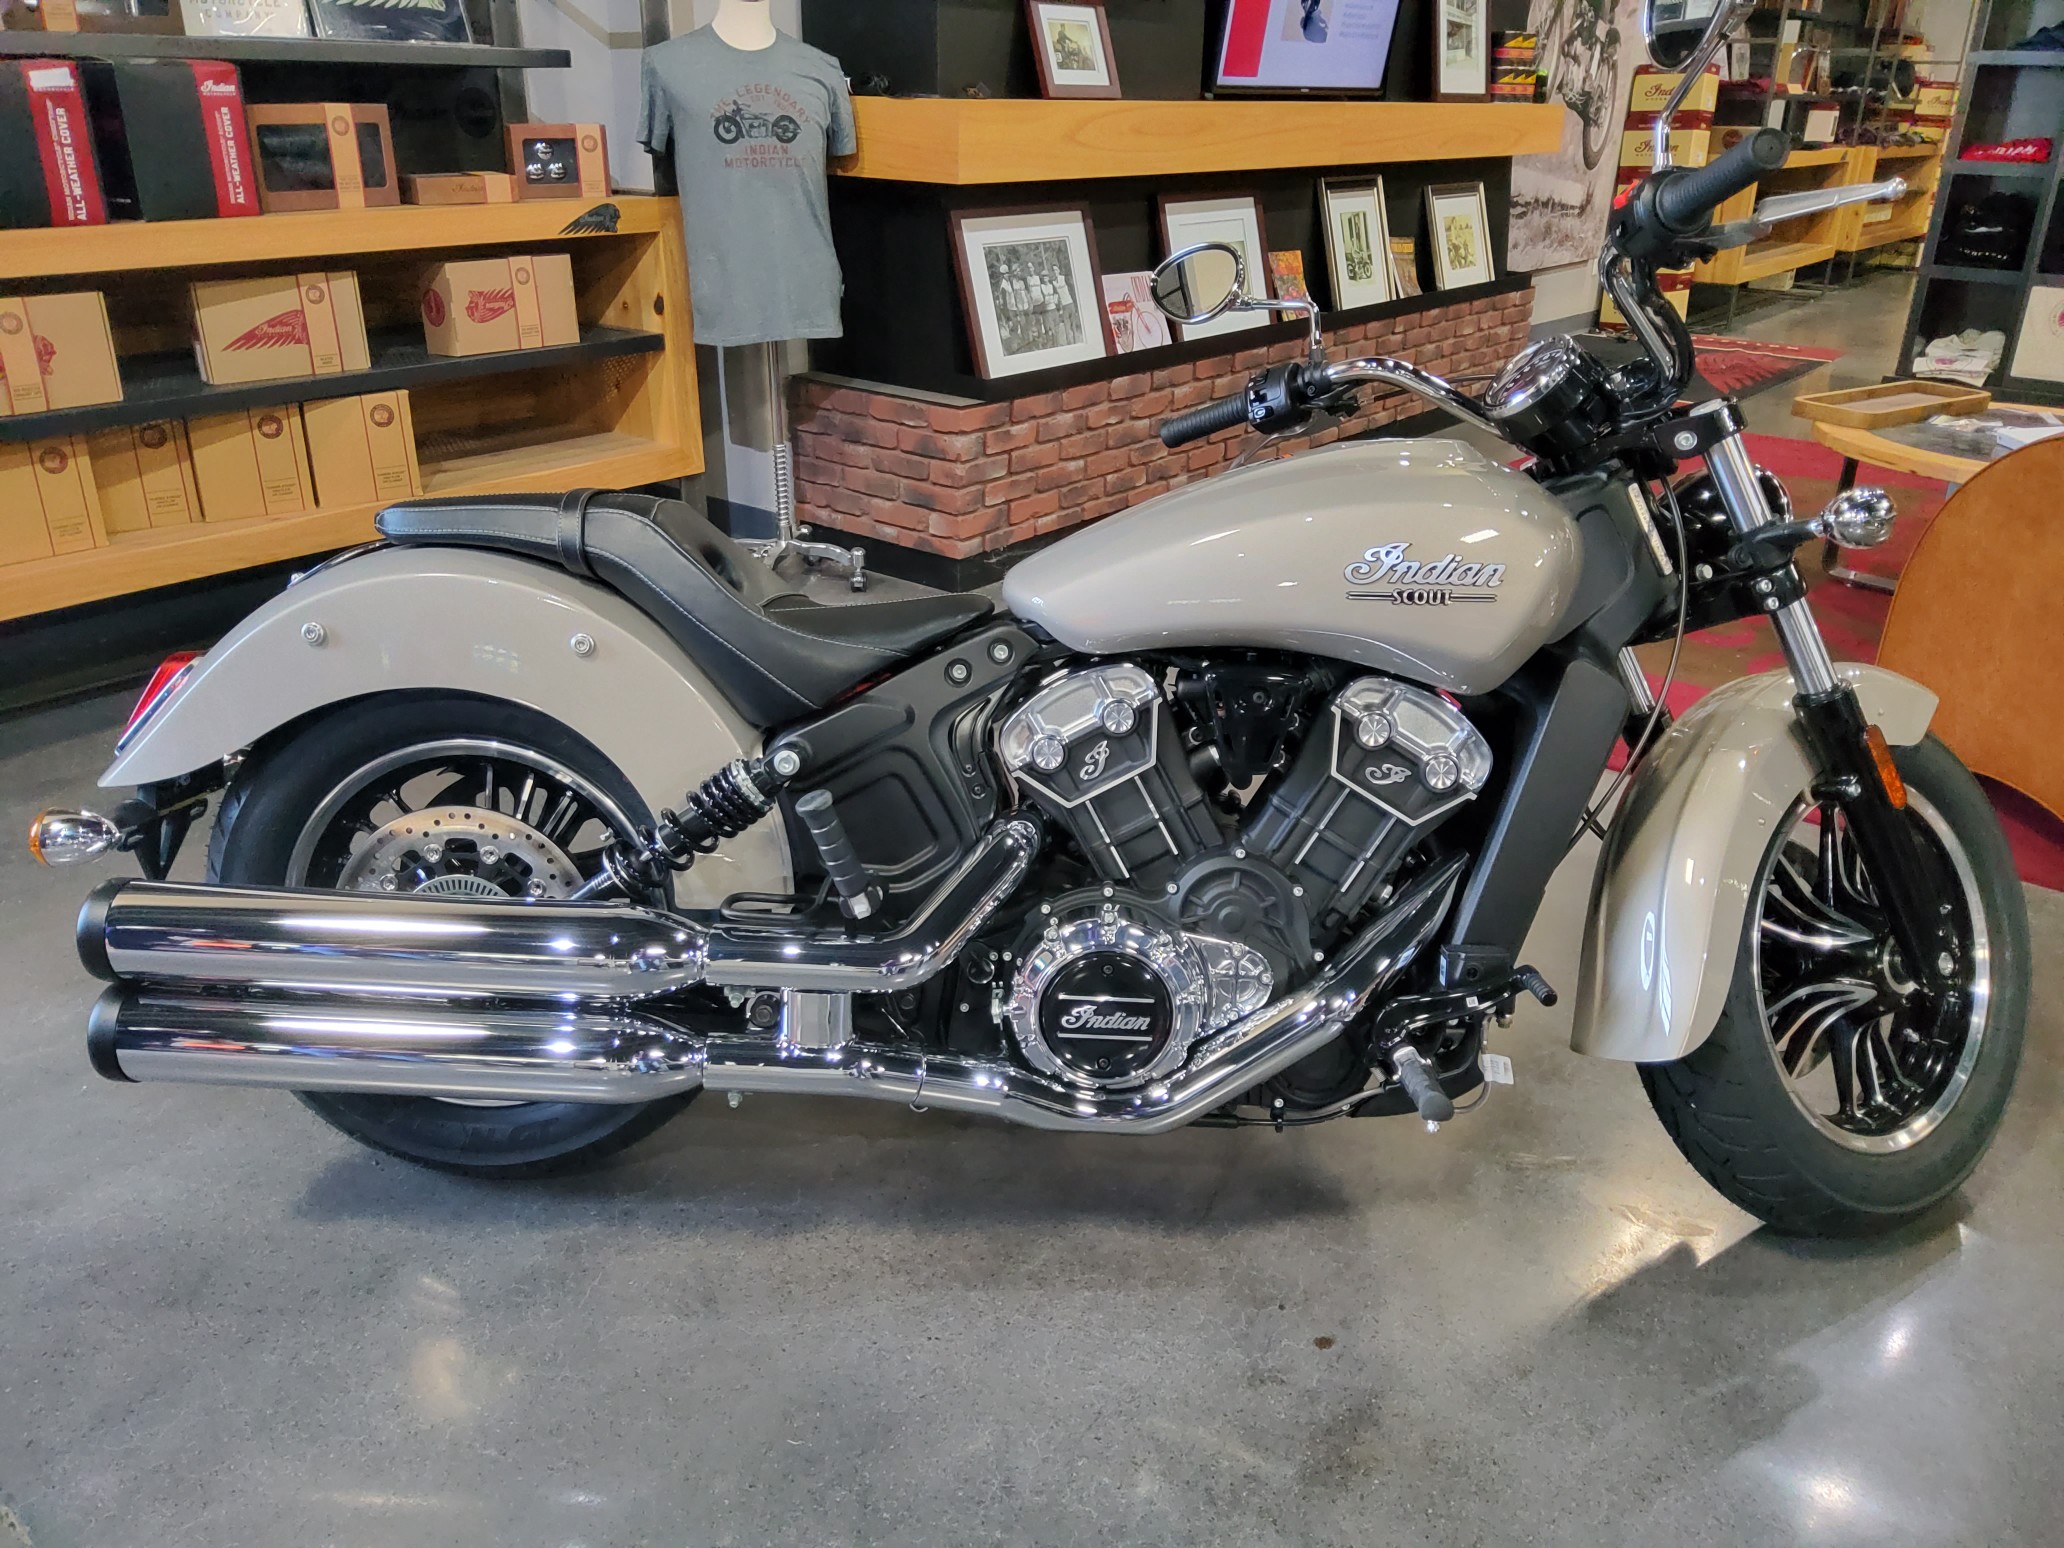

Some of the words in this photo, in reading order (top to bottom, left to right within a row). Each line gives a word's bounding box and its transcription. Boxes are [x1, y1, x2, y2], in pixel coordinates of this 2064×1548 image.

[201, 80, 236, 92] Indian
[736, 83, 811, 124] LEGENDARY
[55, 107, 72, 144] COVER
[220, 106, 234, 138] COVER
[745, 145, 789, 155] INDIAN
[63, 146, 87, 221] ALL-WEATHER
[227, 140, 246, 204] ALL-WEATHER
[255, 323, 293, 336] Indian
[1343, 542, 1506, 588] Indian
[1392, 588, 1453, 606] SCOUT
[1061, 1005, 1151, 1031] Indian
